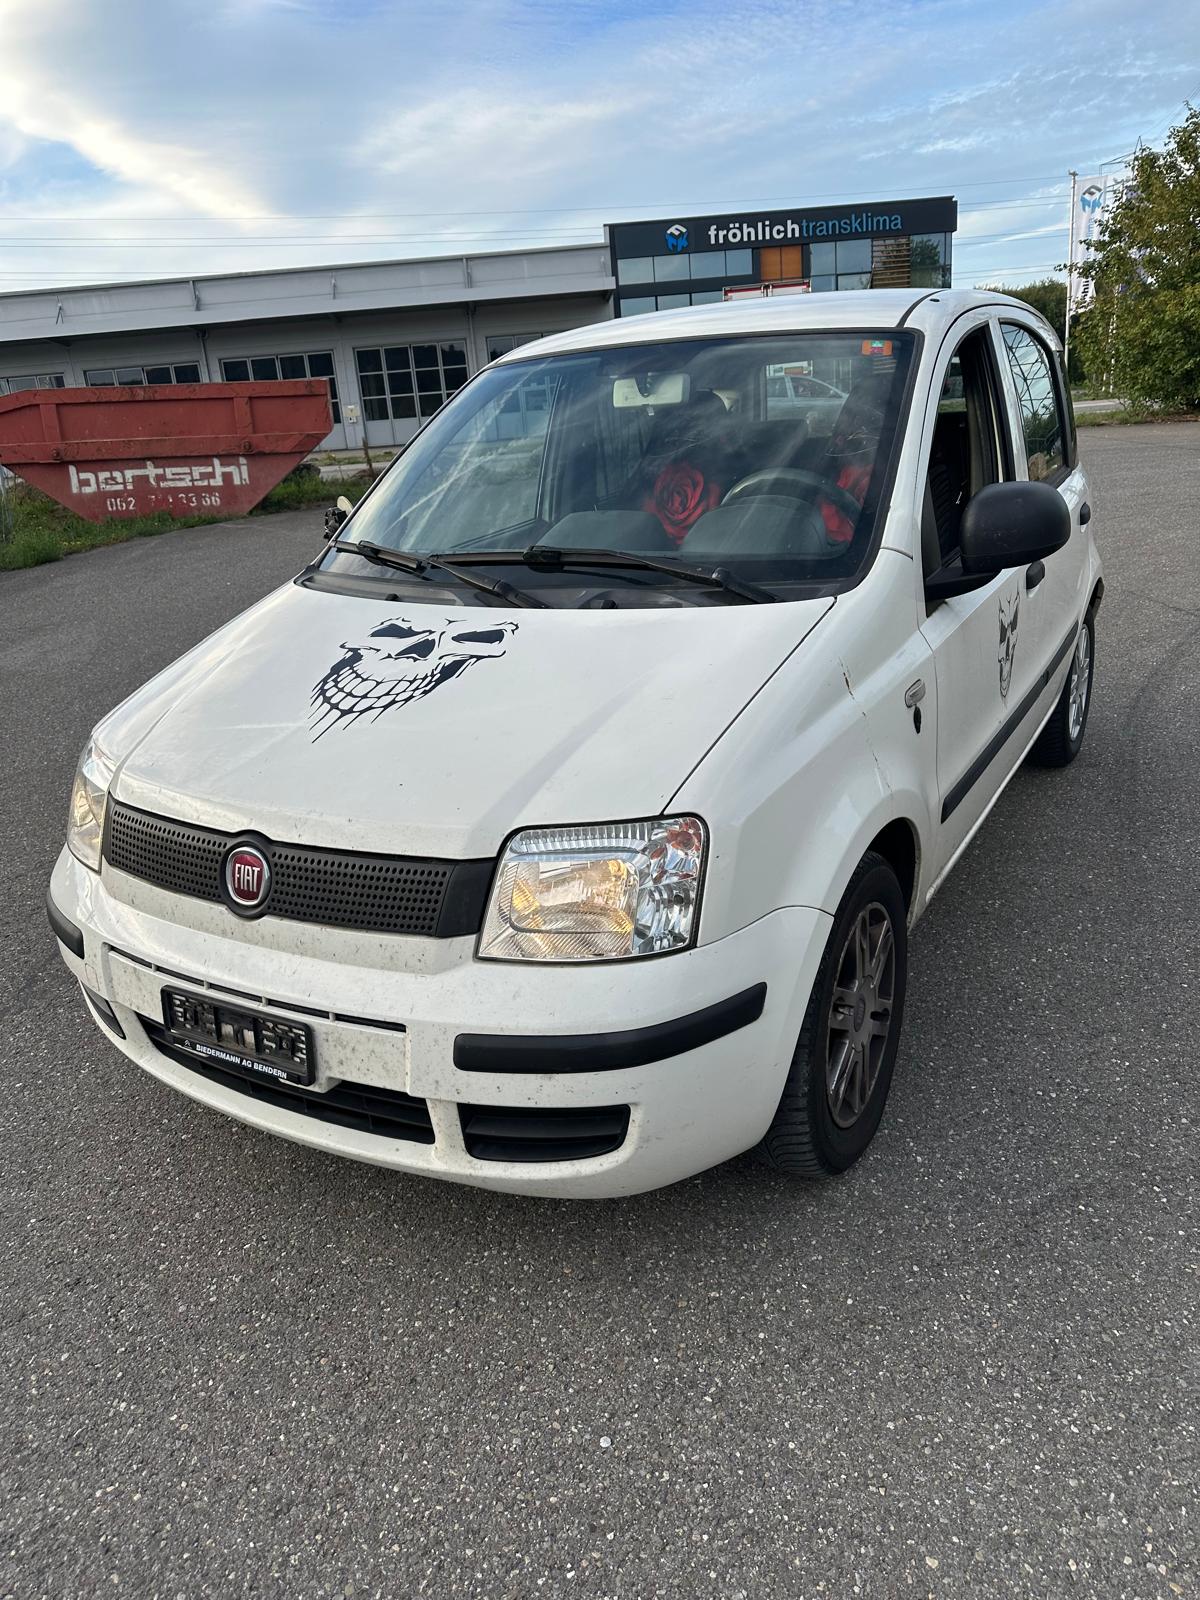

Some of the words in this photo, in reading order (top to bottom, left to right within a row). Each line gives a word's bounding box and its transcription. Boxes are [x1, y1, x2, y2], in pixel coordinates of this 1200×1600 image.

[69, 456, 250, 494] bertschi
[235, 863, 260, 892] FIAT
[196, 1044, 240, 1064] BIEDERMANN
[242, 1059, 252, 1068] AG
[253, 1062, 287, 1079] BENDERN
